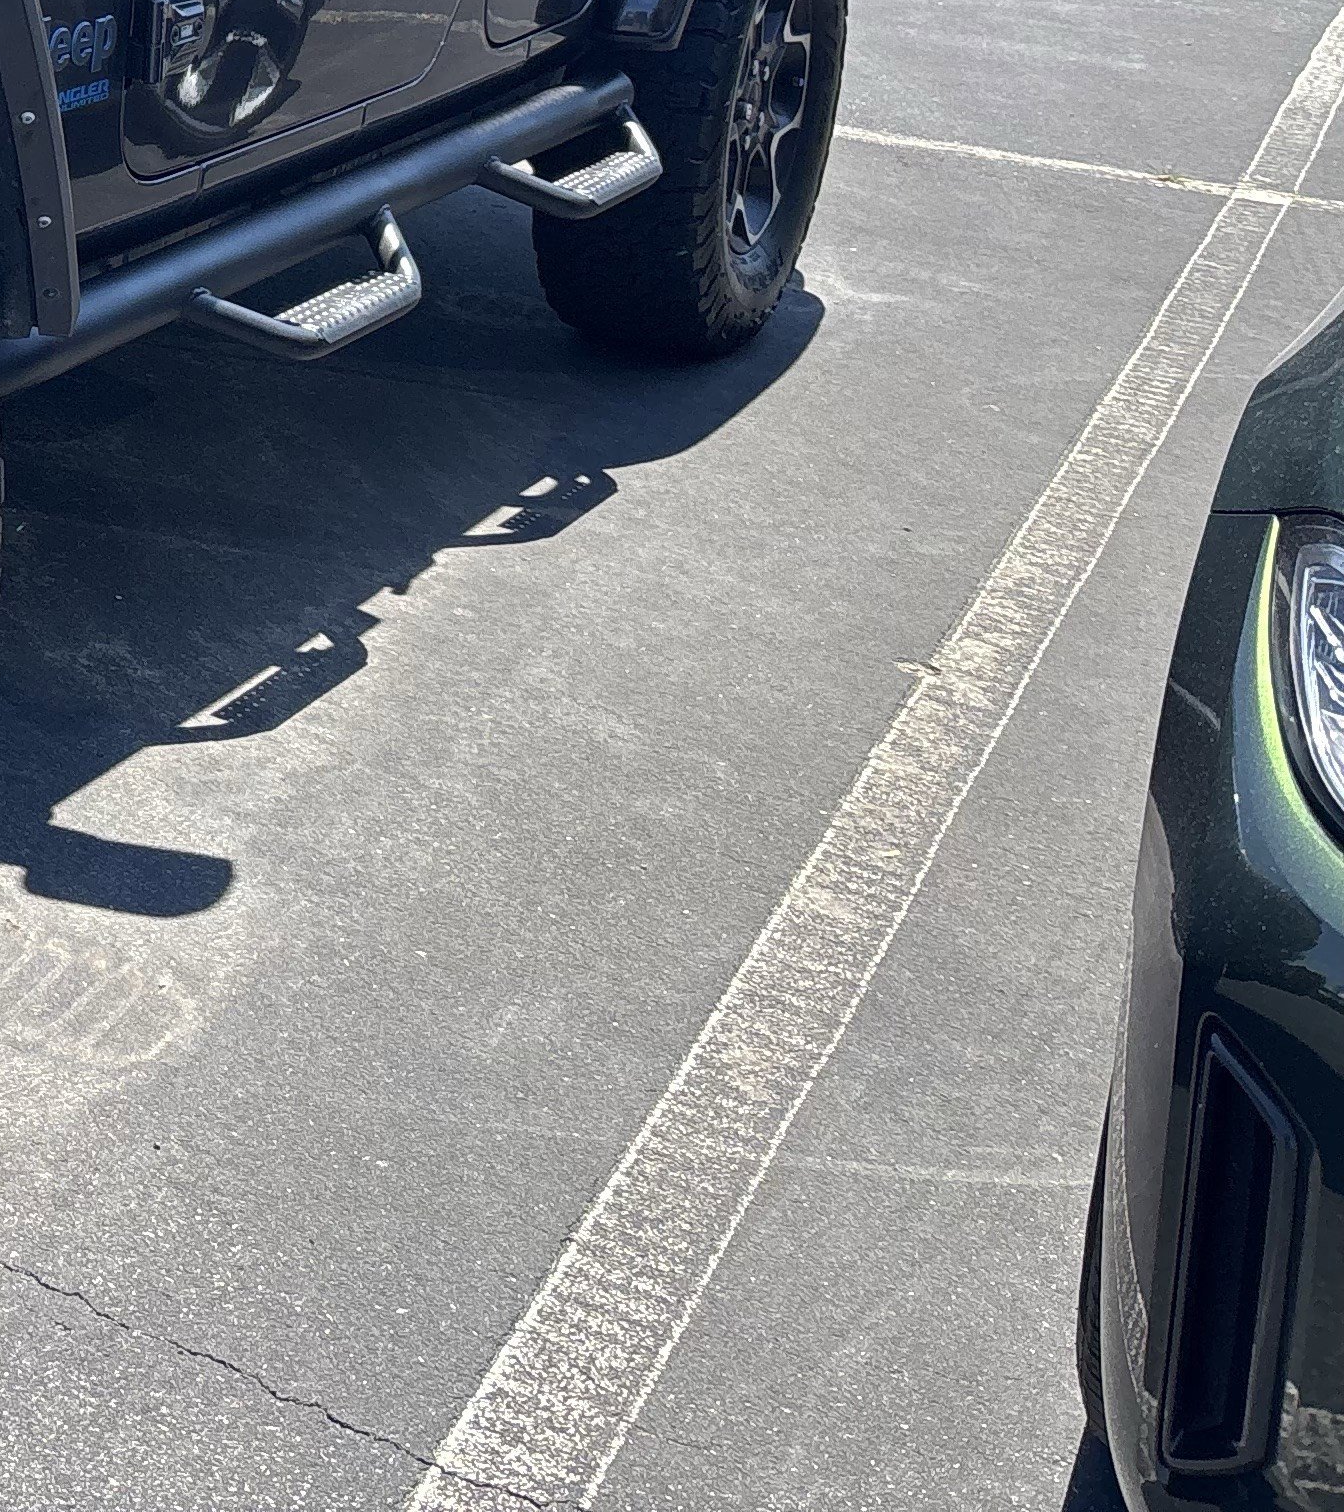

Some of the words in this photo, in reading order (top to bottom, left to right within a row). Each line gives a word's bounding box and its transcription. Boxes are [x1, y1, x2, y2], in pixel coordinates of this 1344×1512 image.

[42, 14, 118, 73] eep
[58, 78, 109, 105] NGLER
[59, 92, 110, 112] LIMITED
